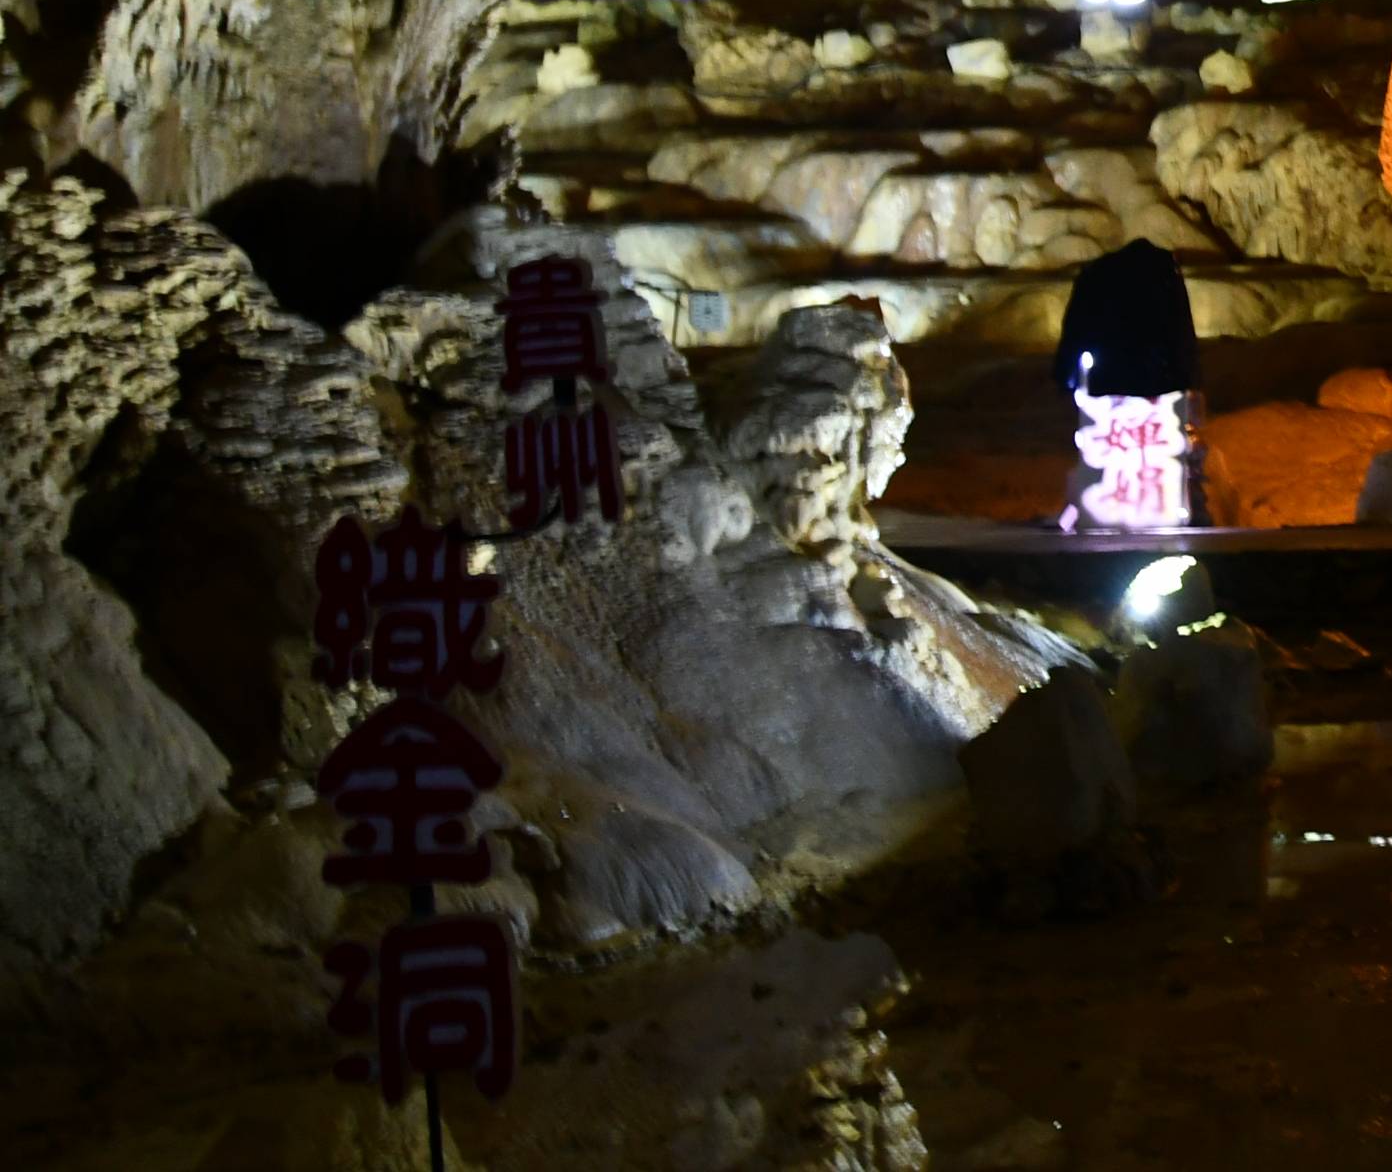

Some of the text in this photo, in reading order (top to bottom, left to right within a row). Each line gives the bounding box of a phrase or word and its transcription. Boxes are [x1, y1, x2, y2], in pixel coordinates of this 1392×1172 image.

[496, 255, 622, 526] 貴州
[312, 506, 519, 1104] 織金洞
